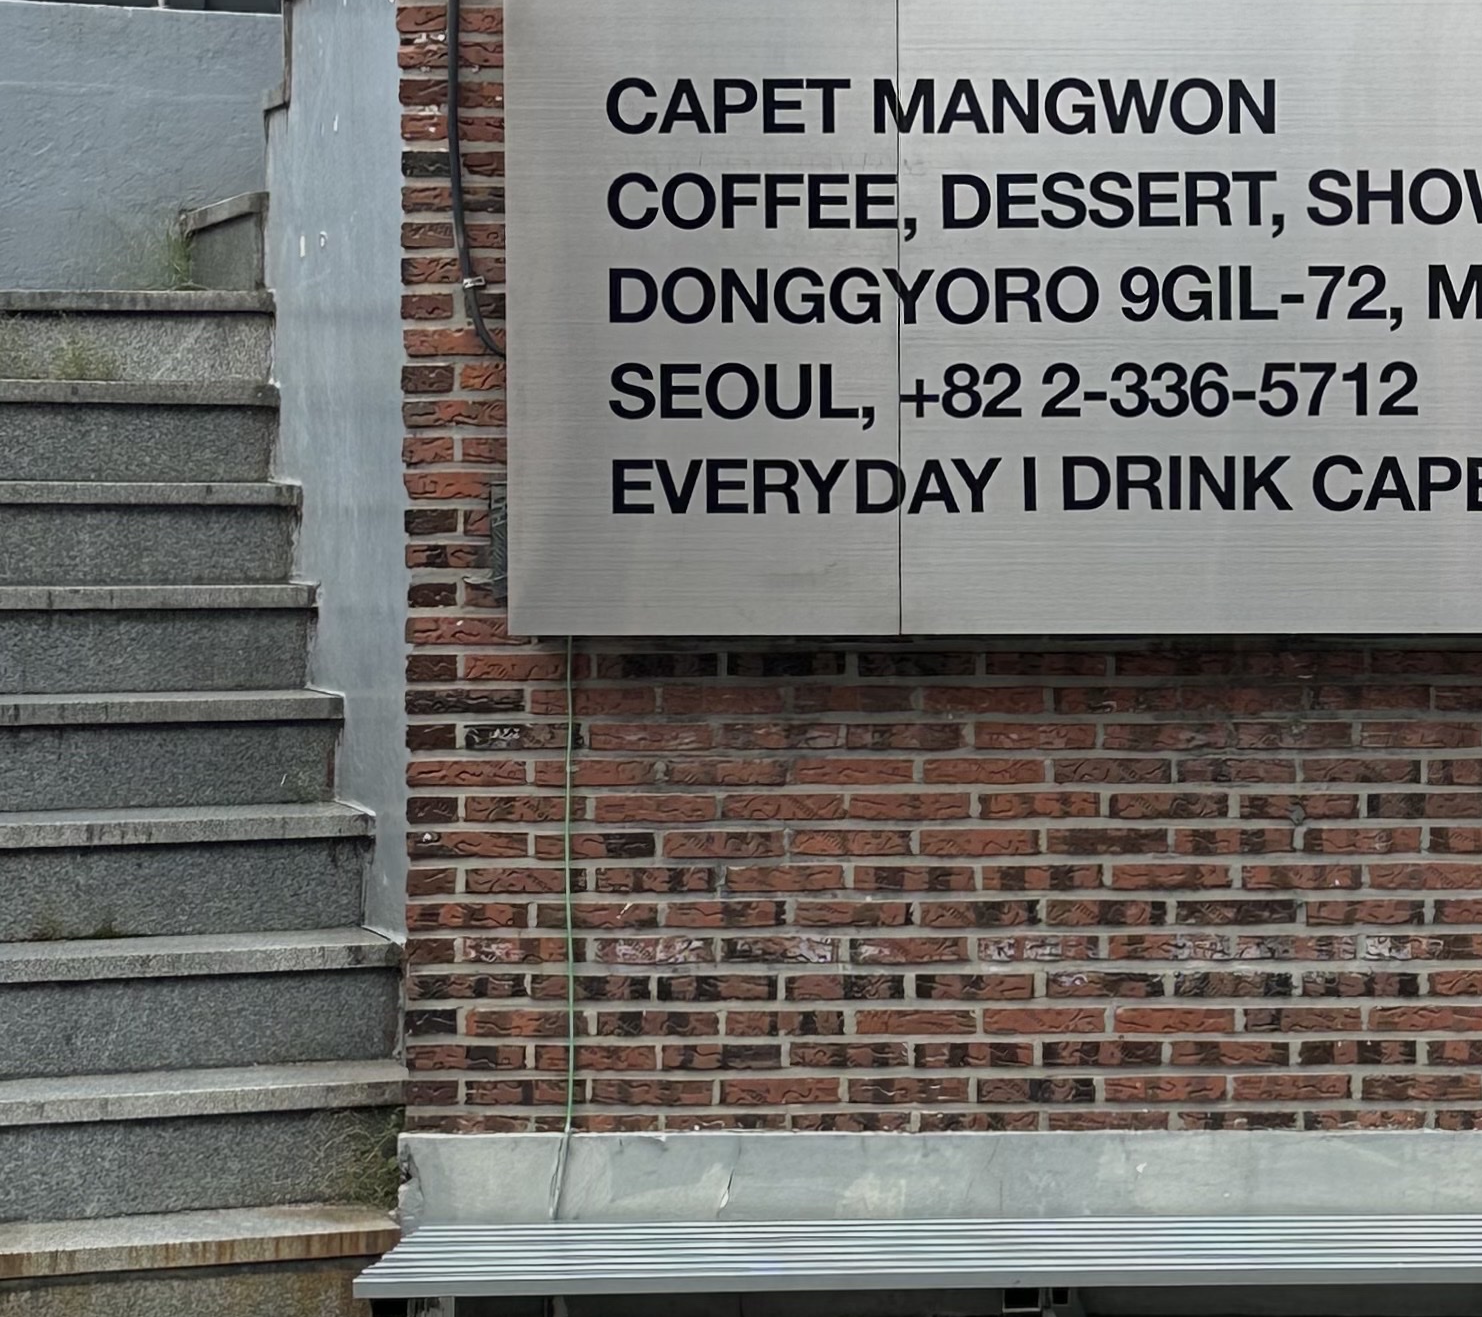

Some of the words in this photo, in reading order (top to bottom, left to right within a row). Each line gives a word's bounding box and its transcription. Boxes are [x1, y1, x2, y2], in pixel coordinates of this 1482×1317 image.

[606, 78, 851, 135] CAPET
[874, 78, 1276, 135] MANGWON
[607, 172, 917, 242] COFFEE,
[942, 170, 1285, 239] DESSERT,
[608, 266, 1100, 325] DONGGYORO
[1120, 264, 1403, 332] 9GIL-72,
[608, 362, 875, 431] SEOUL,
[899, 362, 1022, 419] +82
[1041, 361, 1419, 419] 2-336-5712
[612, 457, 1002, 515] EVERYDAY
[1023, 456, 1037, 512] I
[1062, 455, 1294, 511] DRINK
